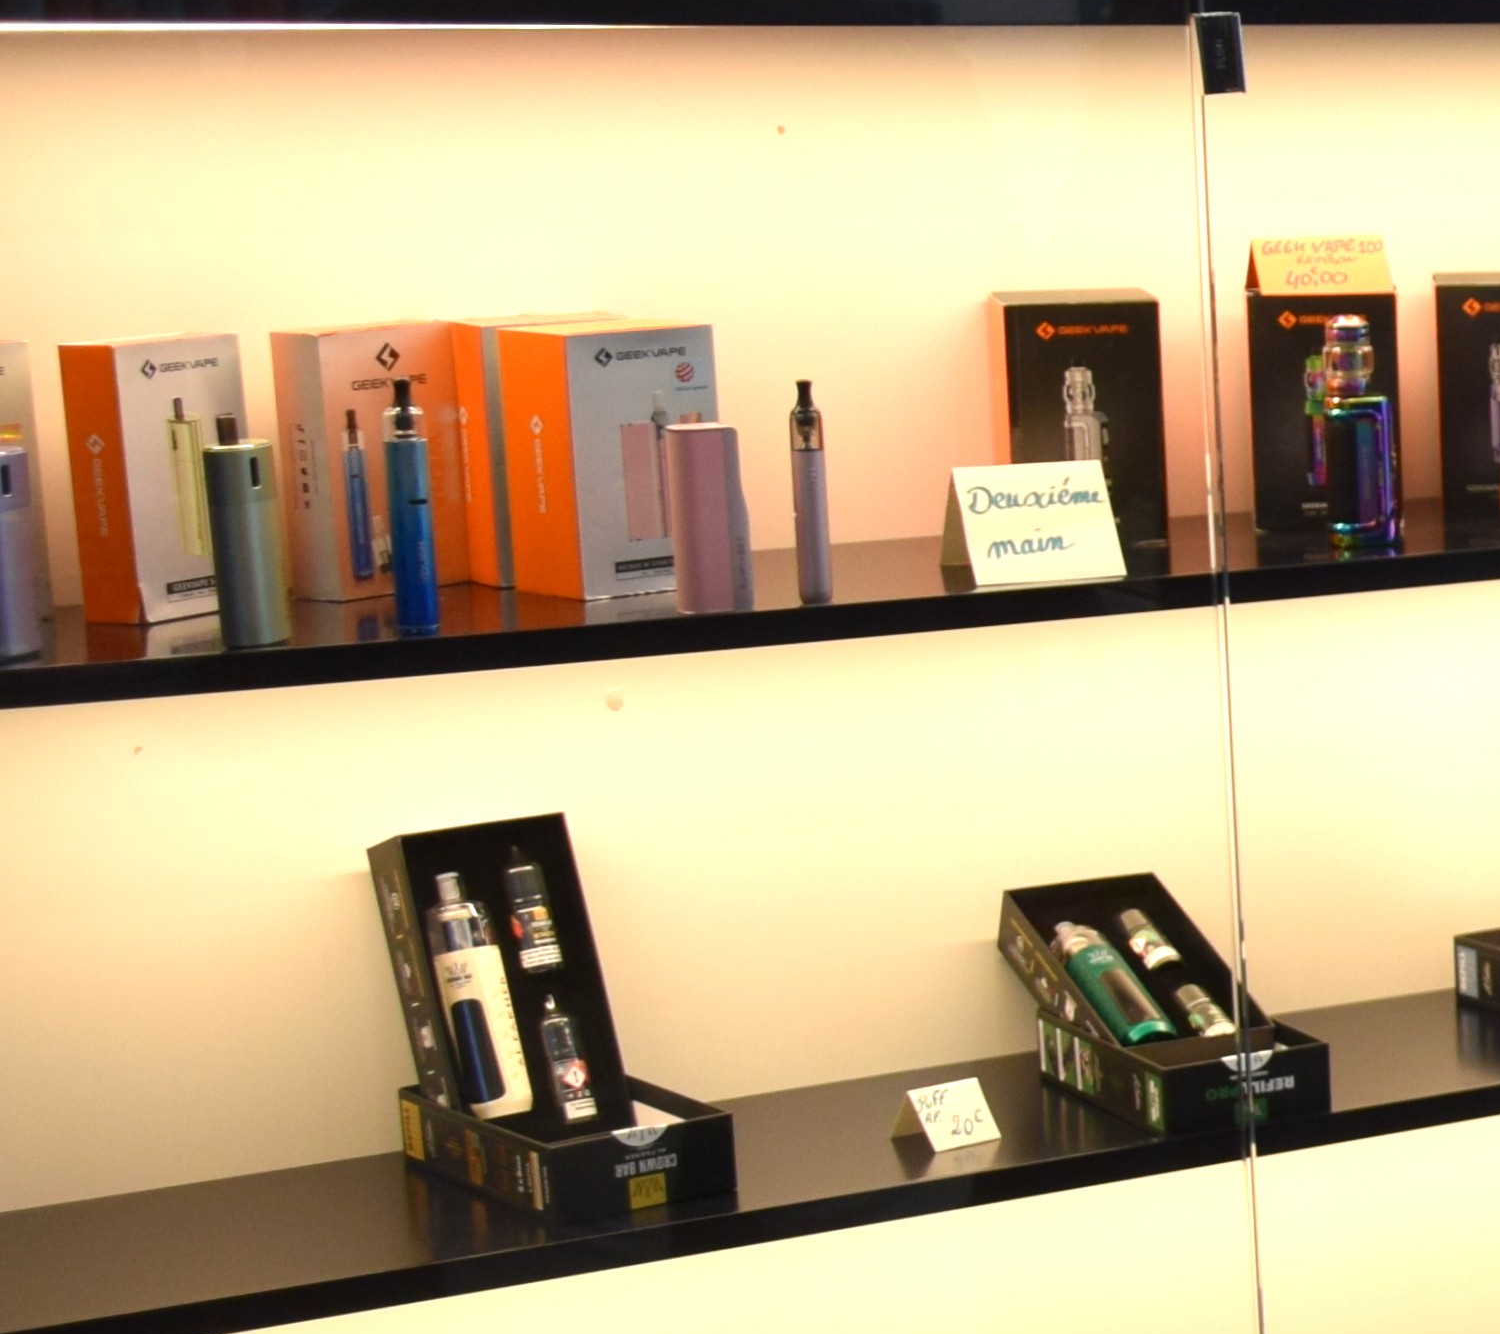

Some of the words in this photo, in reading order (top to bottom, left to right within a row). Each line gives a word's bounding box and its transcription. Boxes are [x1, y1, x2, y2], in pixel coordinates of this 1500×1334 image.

[615, 346, 686, 362] GEEKVAPE
[159, 357, 219, 374] GEEKVAPE
[352, 373, 427, 391] GEEKPE
[987, 532, 1075, 562] main
[616, 1162, 636, 1177] BAR
[639, 1153, 677, 1172] CROWN
